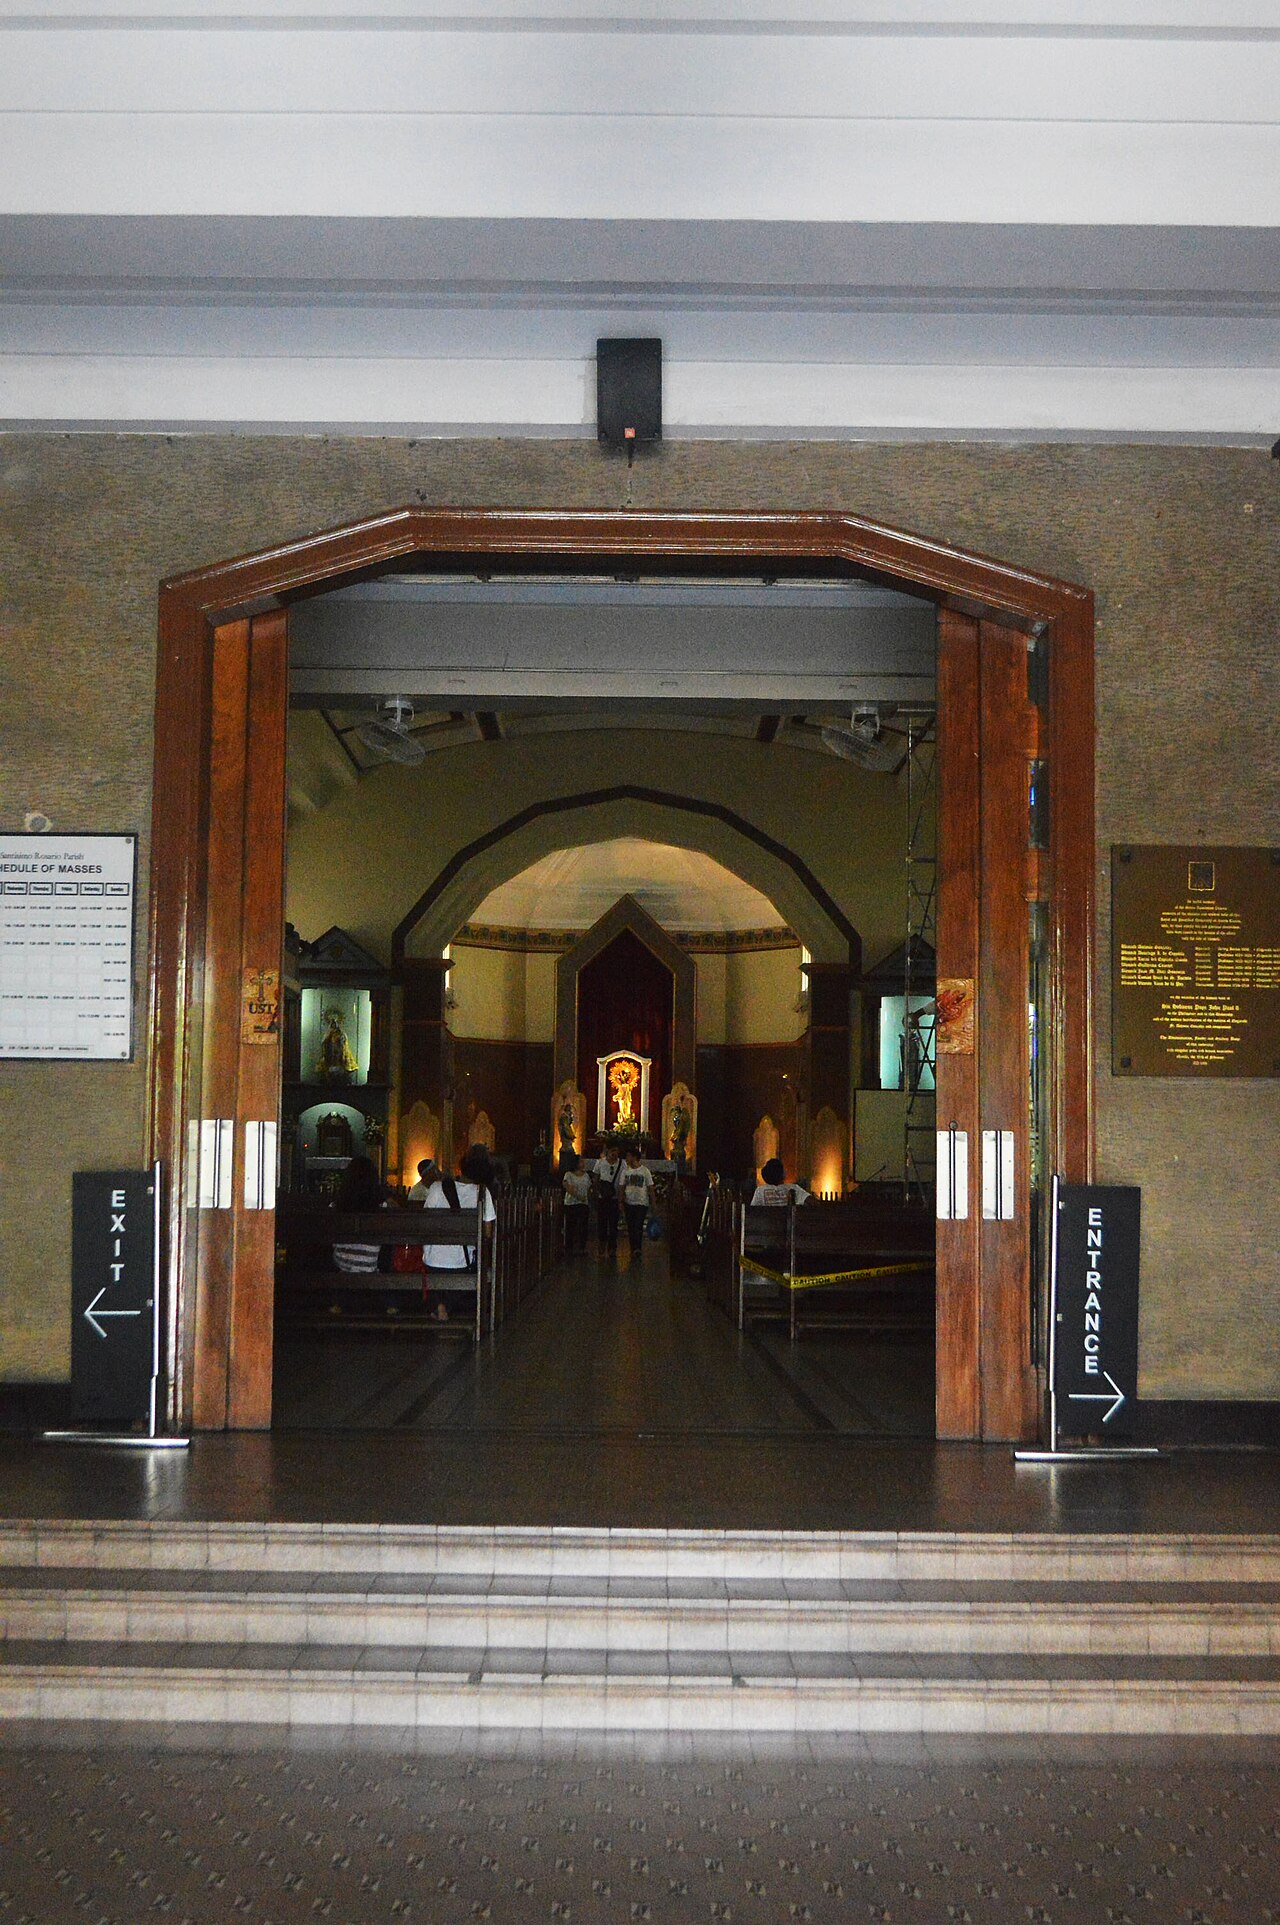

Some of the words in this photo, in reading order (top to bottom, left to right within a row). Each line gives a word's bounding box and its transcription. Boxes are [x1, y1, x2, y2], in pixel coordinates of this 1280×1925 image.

[41, 864, 55, 873] OF
[58, 865, 103, 874] MASSES
[249, 1003, 275, 1015] UST
[110, 1189, 126, 1282] EXIT
[794, 1277, 831, 1286] CAUTION
[835, 1271, 872, 1281] CAUTION
[1084, 1207, 1102, 1374] ENTRANCE
